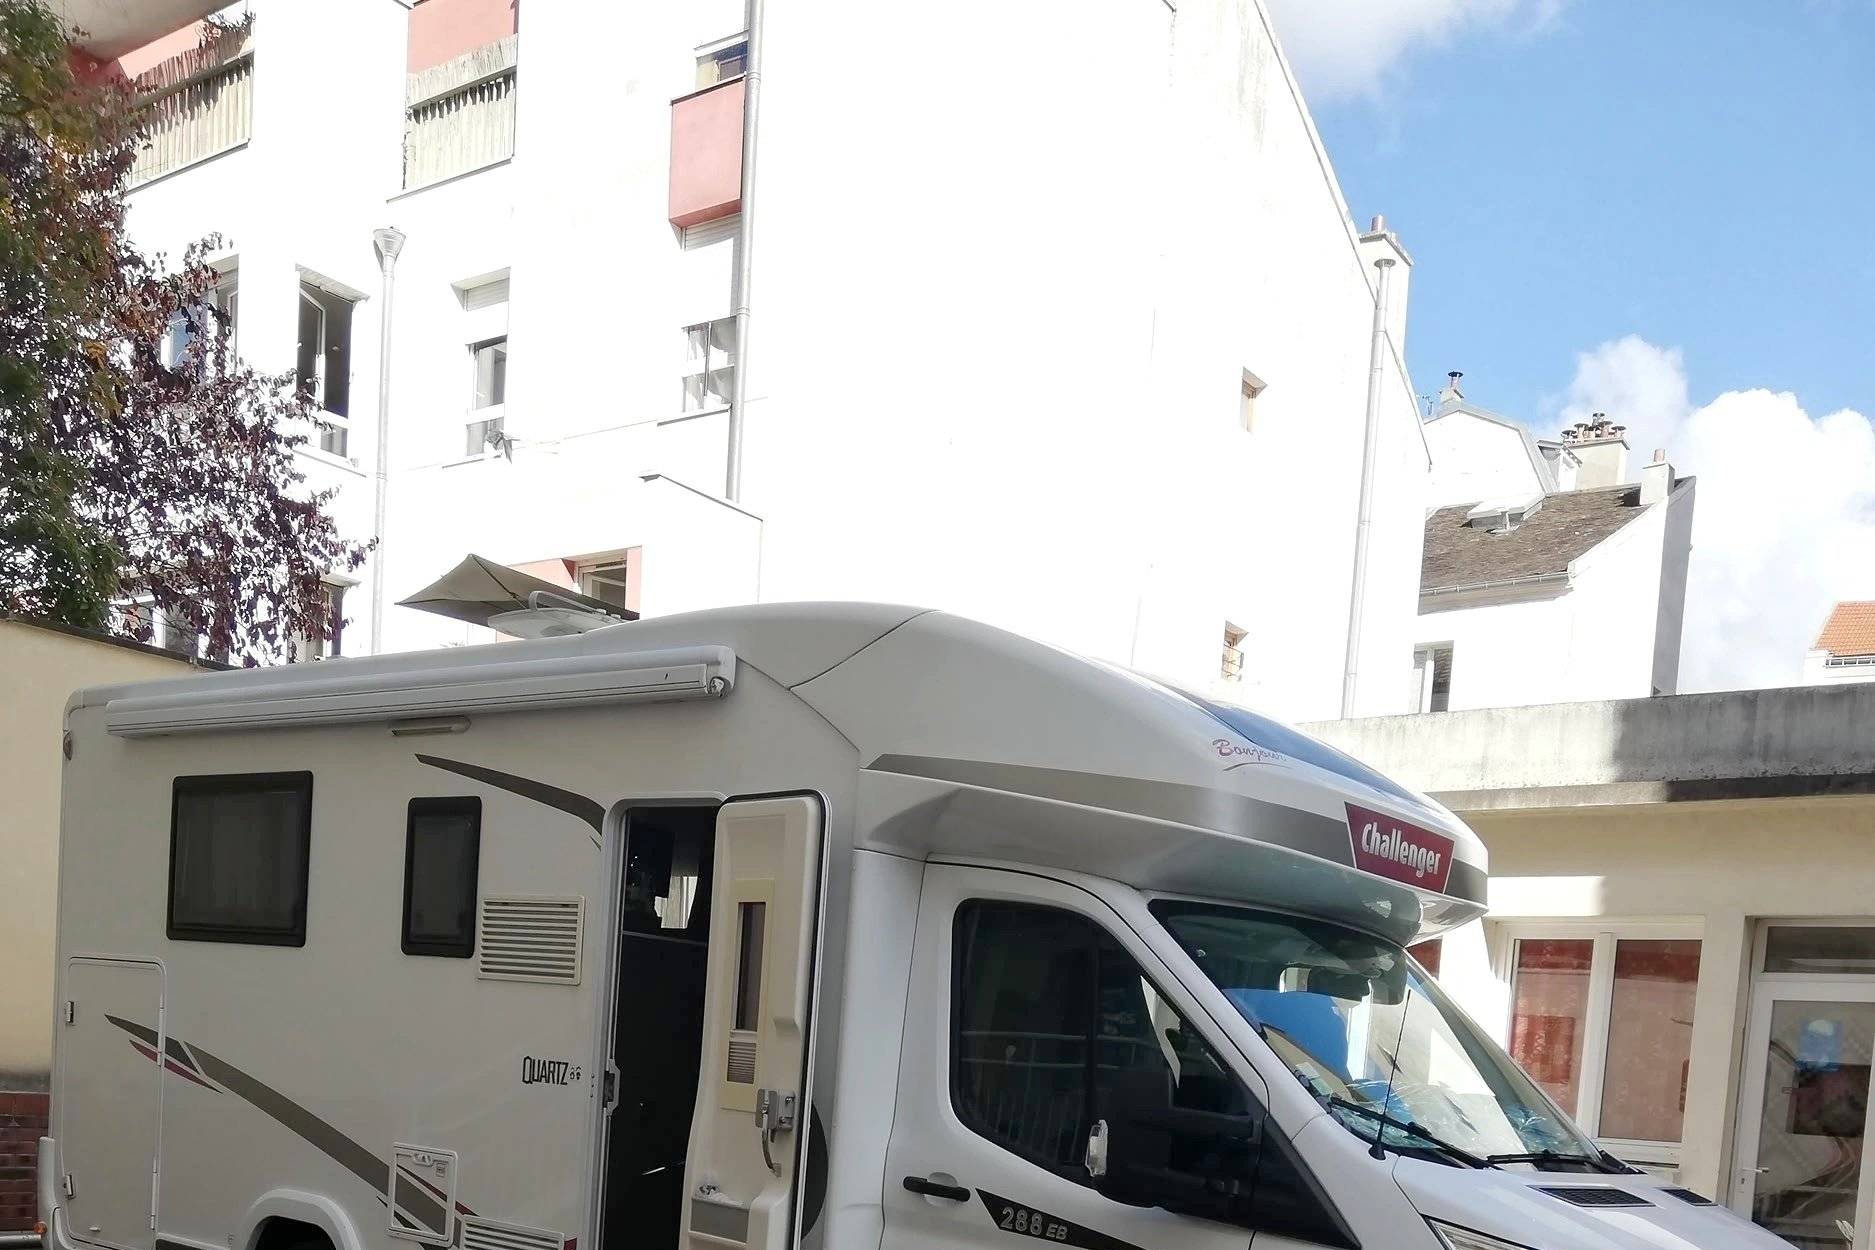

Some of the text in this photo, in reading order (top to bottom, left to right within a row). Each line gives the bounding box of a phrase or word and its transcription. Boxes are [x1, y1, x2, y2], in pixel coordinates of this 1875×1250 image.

[1361, 822, 1441, 877] Challenger
[1001, 1206, 1068, 1240] 288 EB
